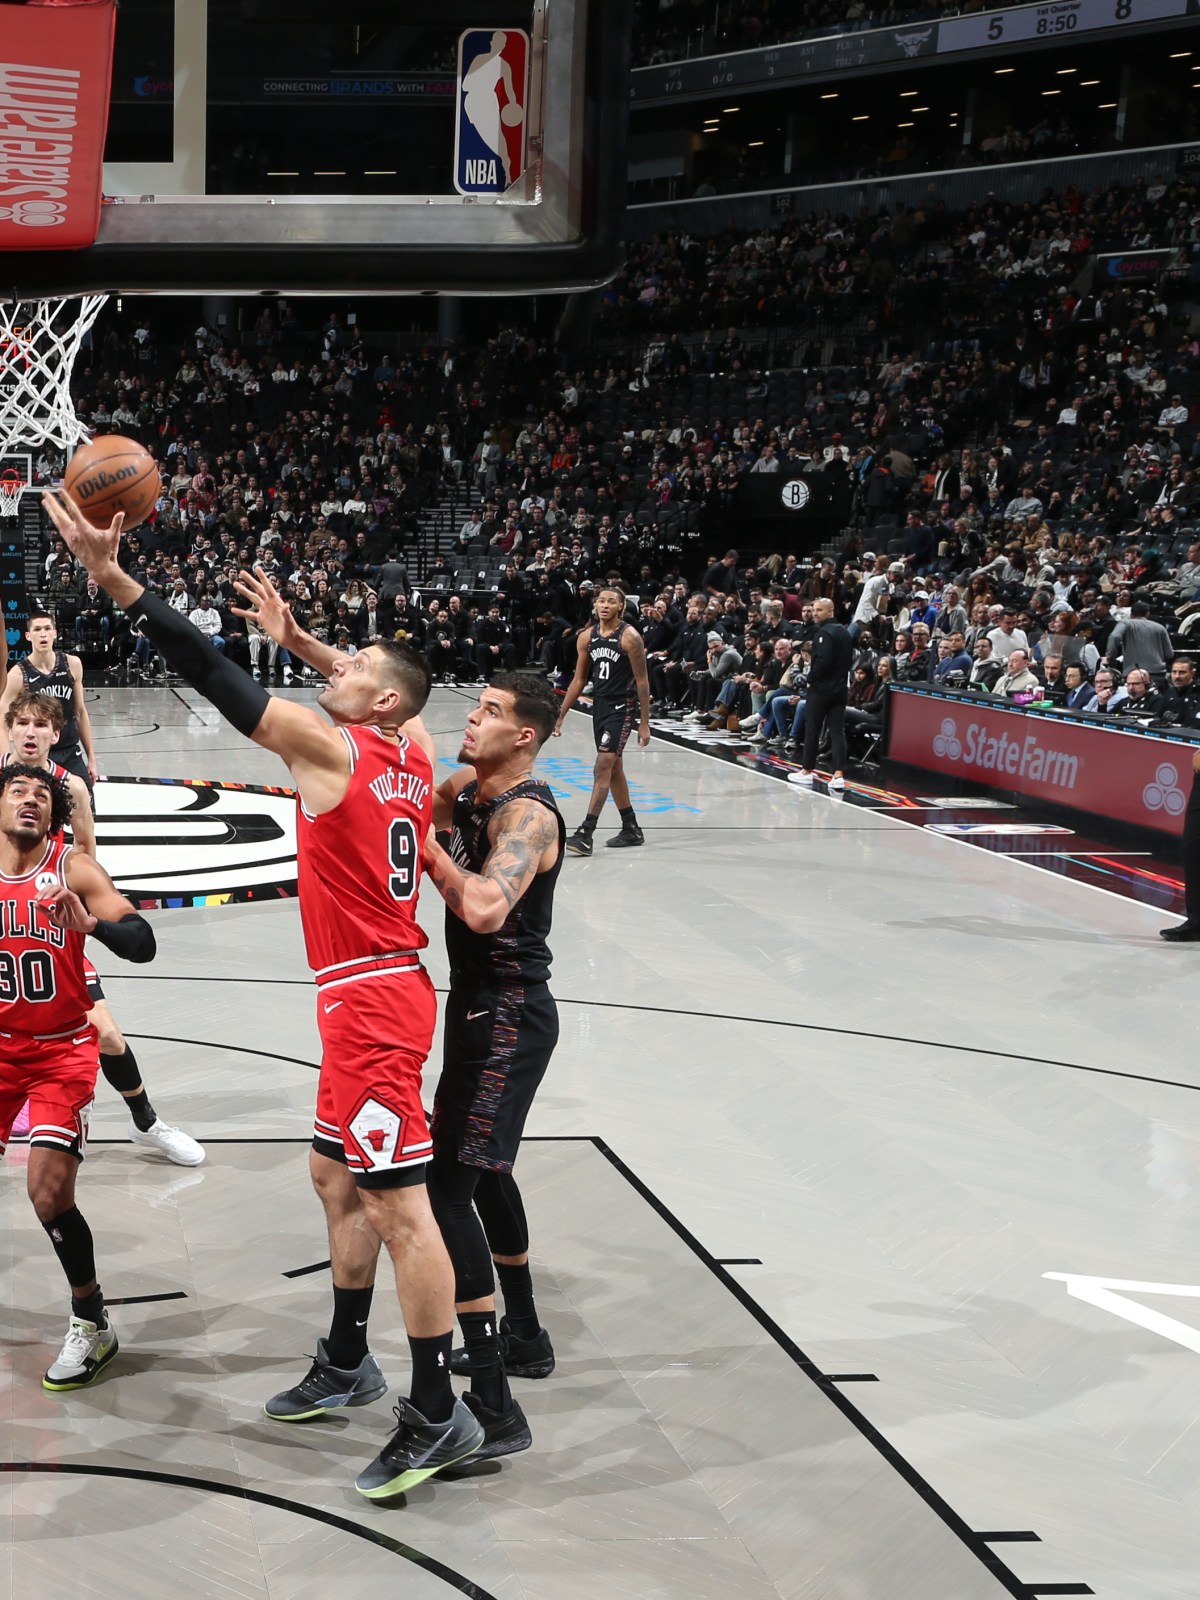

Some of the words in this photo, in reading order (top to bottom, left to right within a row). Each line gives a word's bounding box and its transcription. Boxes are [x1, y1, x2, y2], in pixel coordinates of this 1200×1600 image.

[1036, 8, 1049, 16] 1st
[1050, 2, 1082, 14] Quarter
[1036, 14, 1077, 34] 8:50
[1115, 0, 1132, 20] 8
[987, 17, 1003, 40] 5
[858, 54, 865, 63] 7
[134, 75, 173, 96] Coyot
[263, 82, 328, 92] CONNECTING
[330, 80, 394, 94] BRANDS
[397, 82, 425, 92] WITH
[426, 82, 455, 94] FAN
[465, 159, 498, 185] NBA
[76, 466, 138, 499] Wilson
[590, 647, 620, 662] BROOKLYN
[599, 661, 609, 680] 21
[36, 684, 73, 700] OOKLYN
[368, 766, 430, 810] VUČEVIĆ
[388, 817, 418, 901] 9
